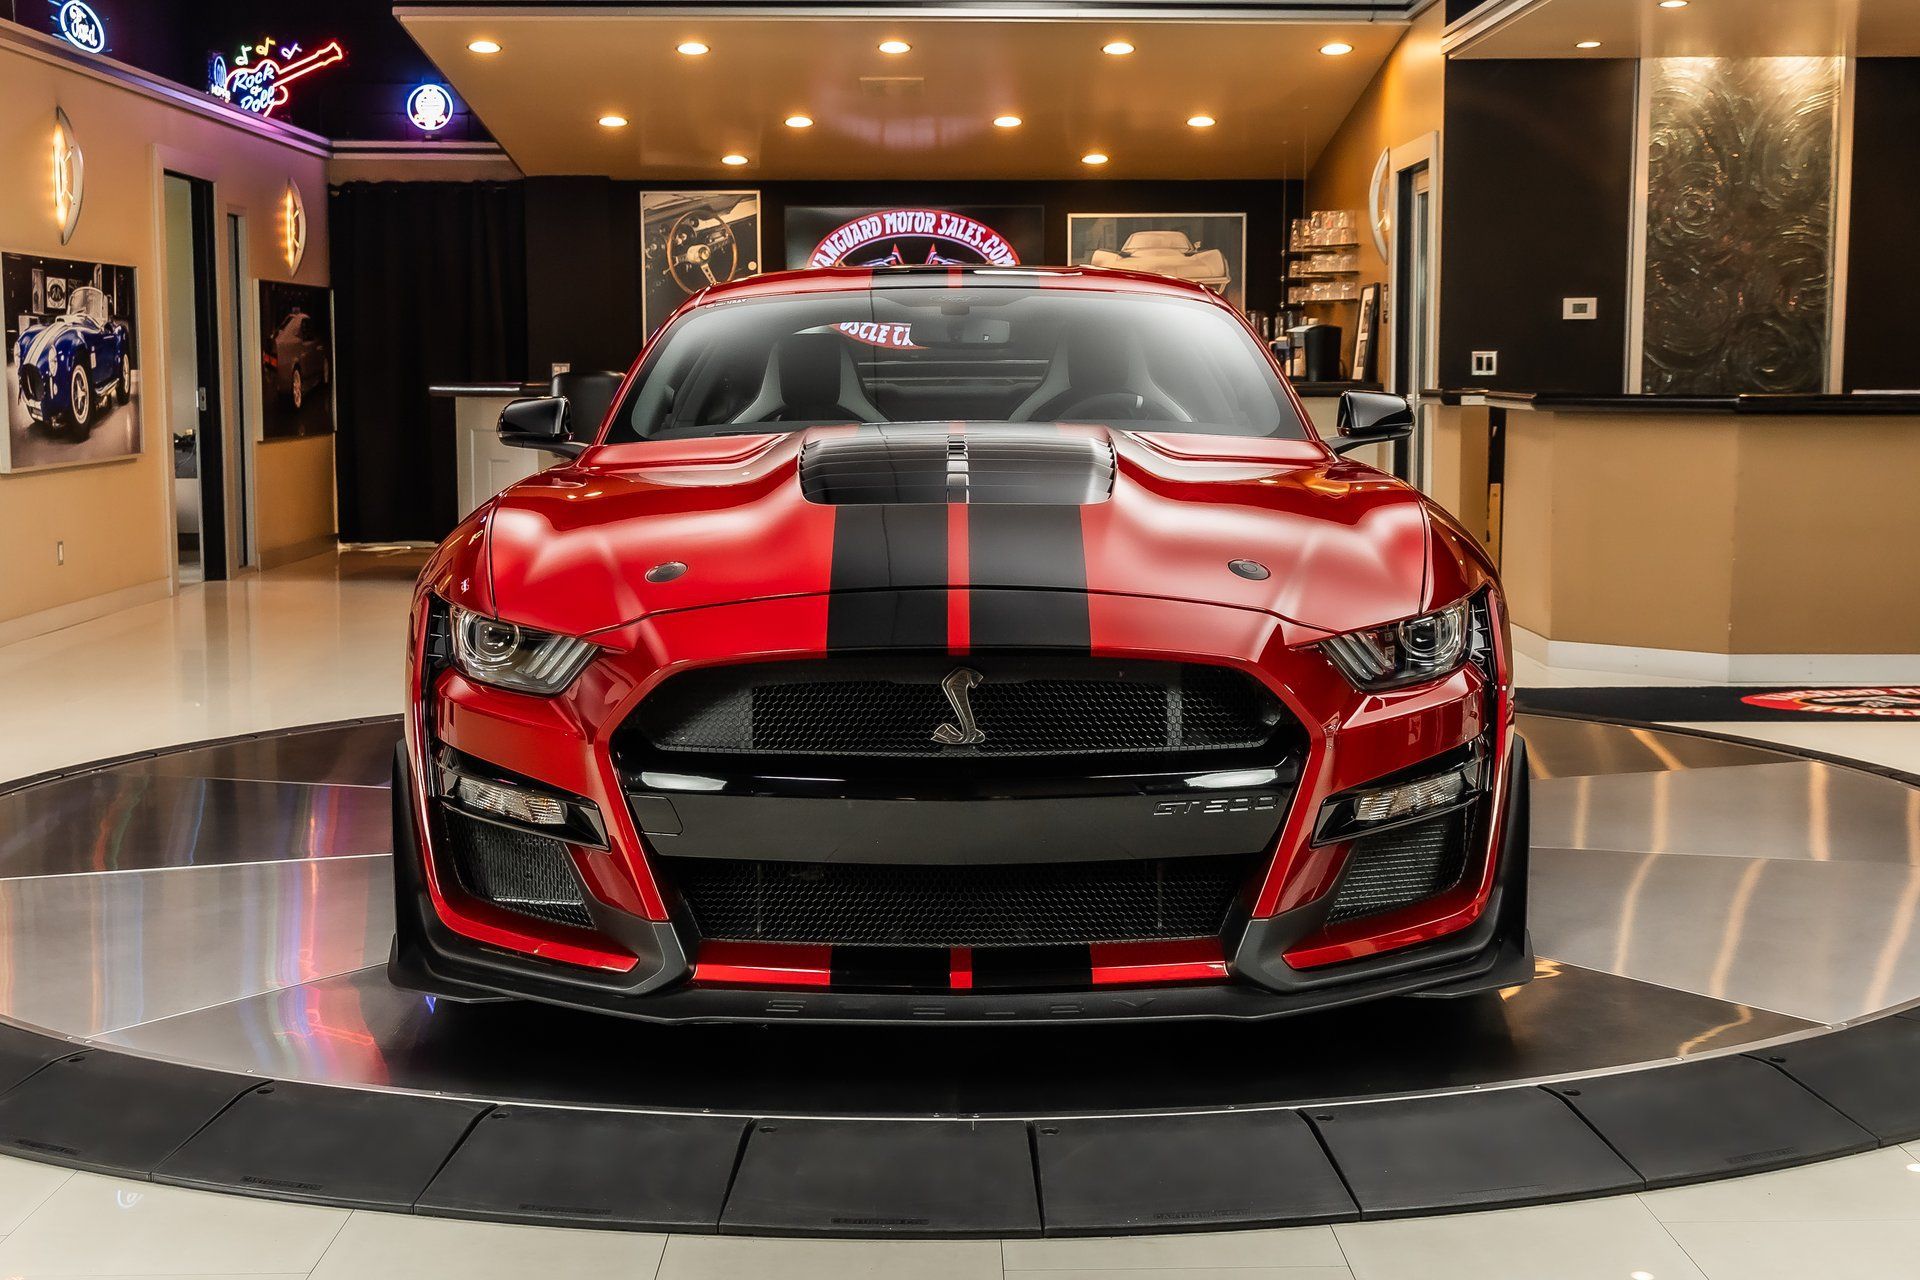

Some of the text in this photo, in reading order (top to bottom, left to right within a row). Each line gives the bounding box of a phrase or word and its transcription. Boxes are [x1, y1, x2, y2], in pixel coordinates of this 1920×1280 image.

[70, 5, 98, 47] Ford
[232, 63, 275, 92] Rock
[883, 211, 936, 235] MOTOR
